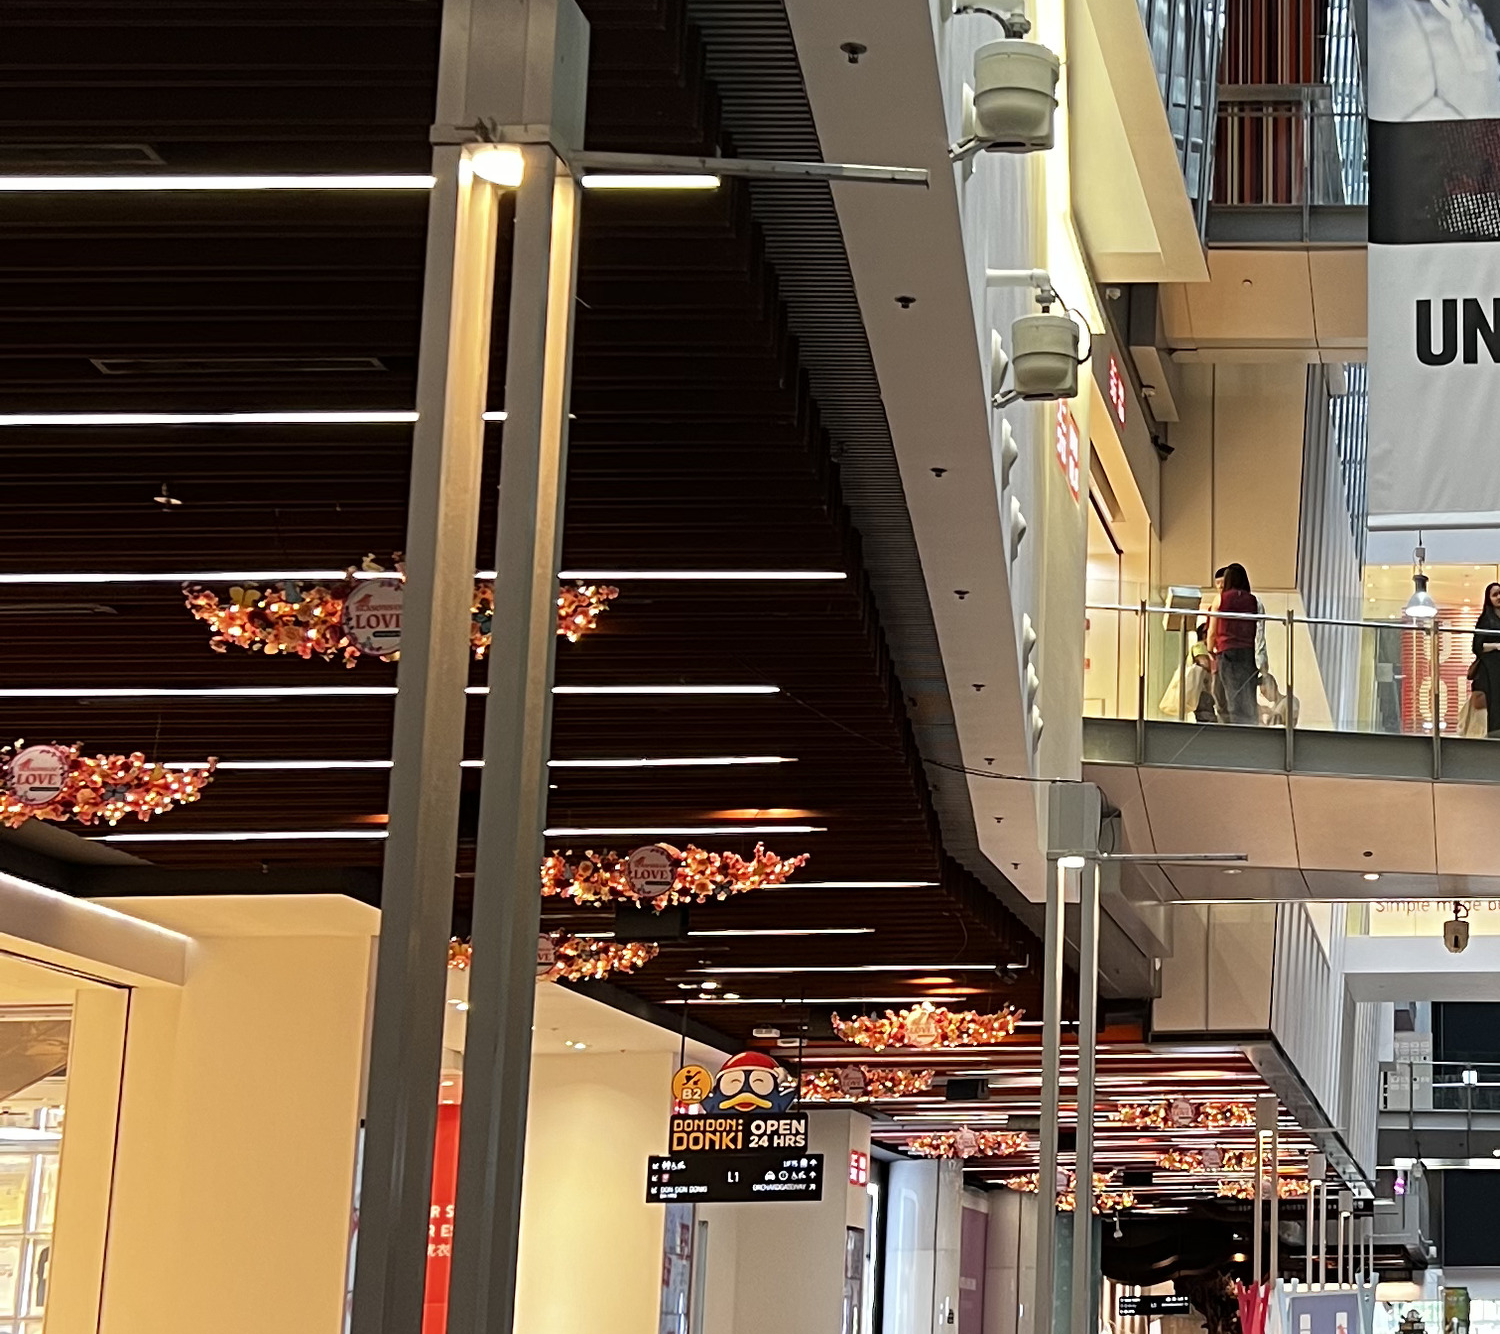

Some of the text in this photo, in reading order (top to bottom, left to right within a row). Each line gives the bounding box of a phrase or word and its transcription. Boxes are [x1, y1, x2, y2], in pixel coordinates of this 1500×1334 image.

[16, 773, 58, 785] LOVE
[634, 869, 669, 880] LOVE
[1375, 901, 1430, 915] Simple
[1436, 901, 1481, 912] mde
[682, 1088, 701, 1100] B2
[750, 1120, 805, 1135] OPEN
[672, 1132, 805, 1151] DONKI 24 HRS
[728, 1171, 739, 1183] L1
